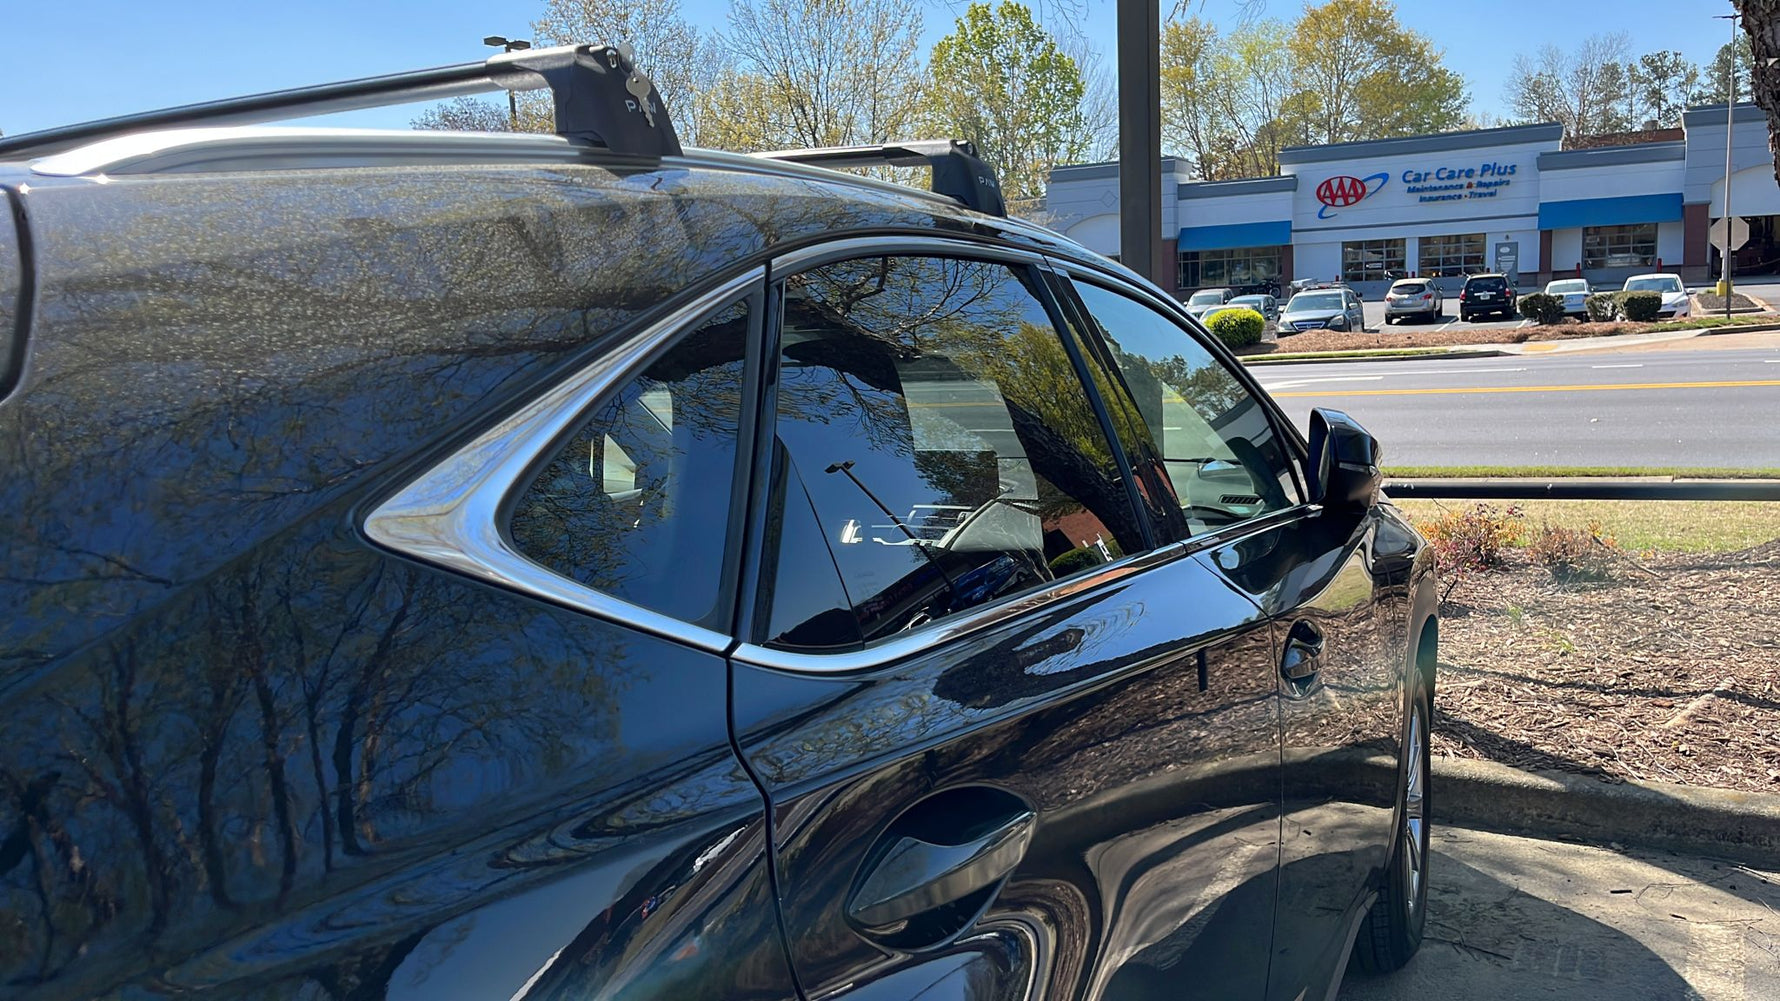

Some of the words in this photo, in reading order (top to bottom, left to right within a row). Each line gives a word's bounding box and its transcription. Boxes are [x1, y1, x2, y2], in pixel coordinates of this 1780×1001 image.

[1401, 170, 1431, 183] Car
[1435, 167, 1475, 181] Care
[1479, 162, 1517, 177] Plus
[1320, 177, 1364, 207] AAA
[1406, 183, 1465, 194] Maintenance
[1475, 178, 1512, 189] Repairs
[1418, 192, 1463, 203] Insurance
[1467, 189, 1497, 199] Travel
